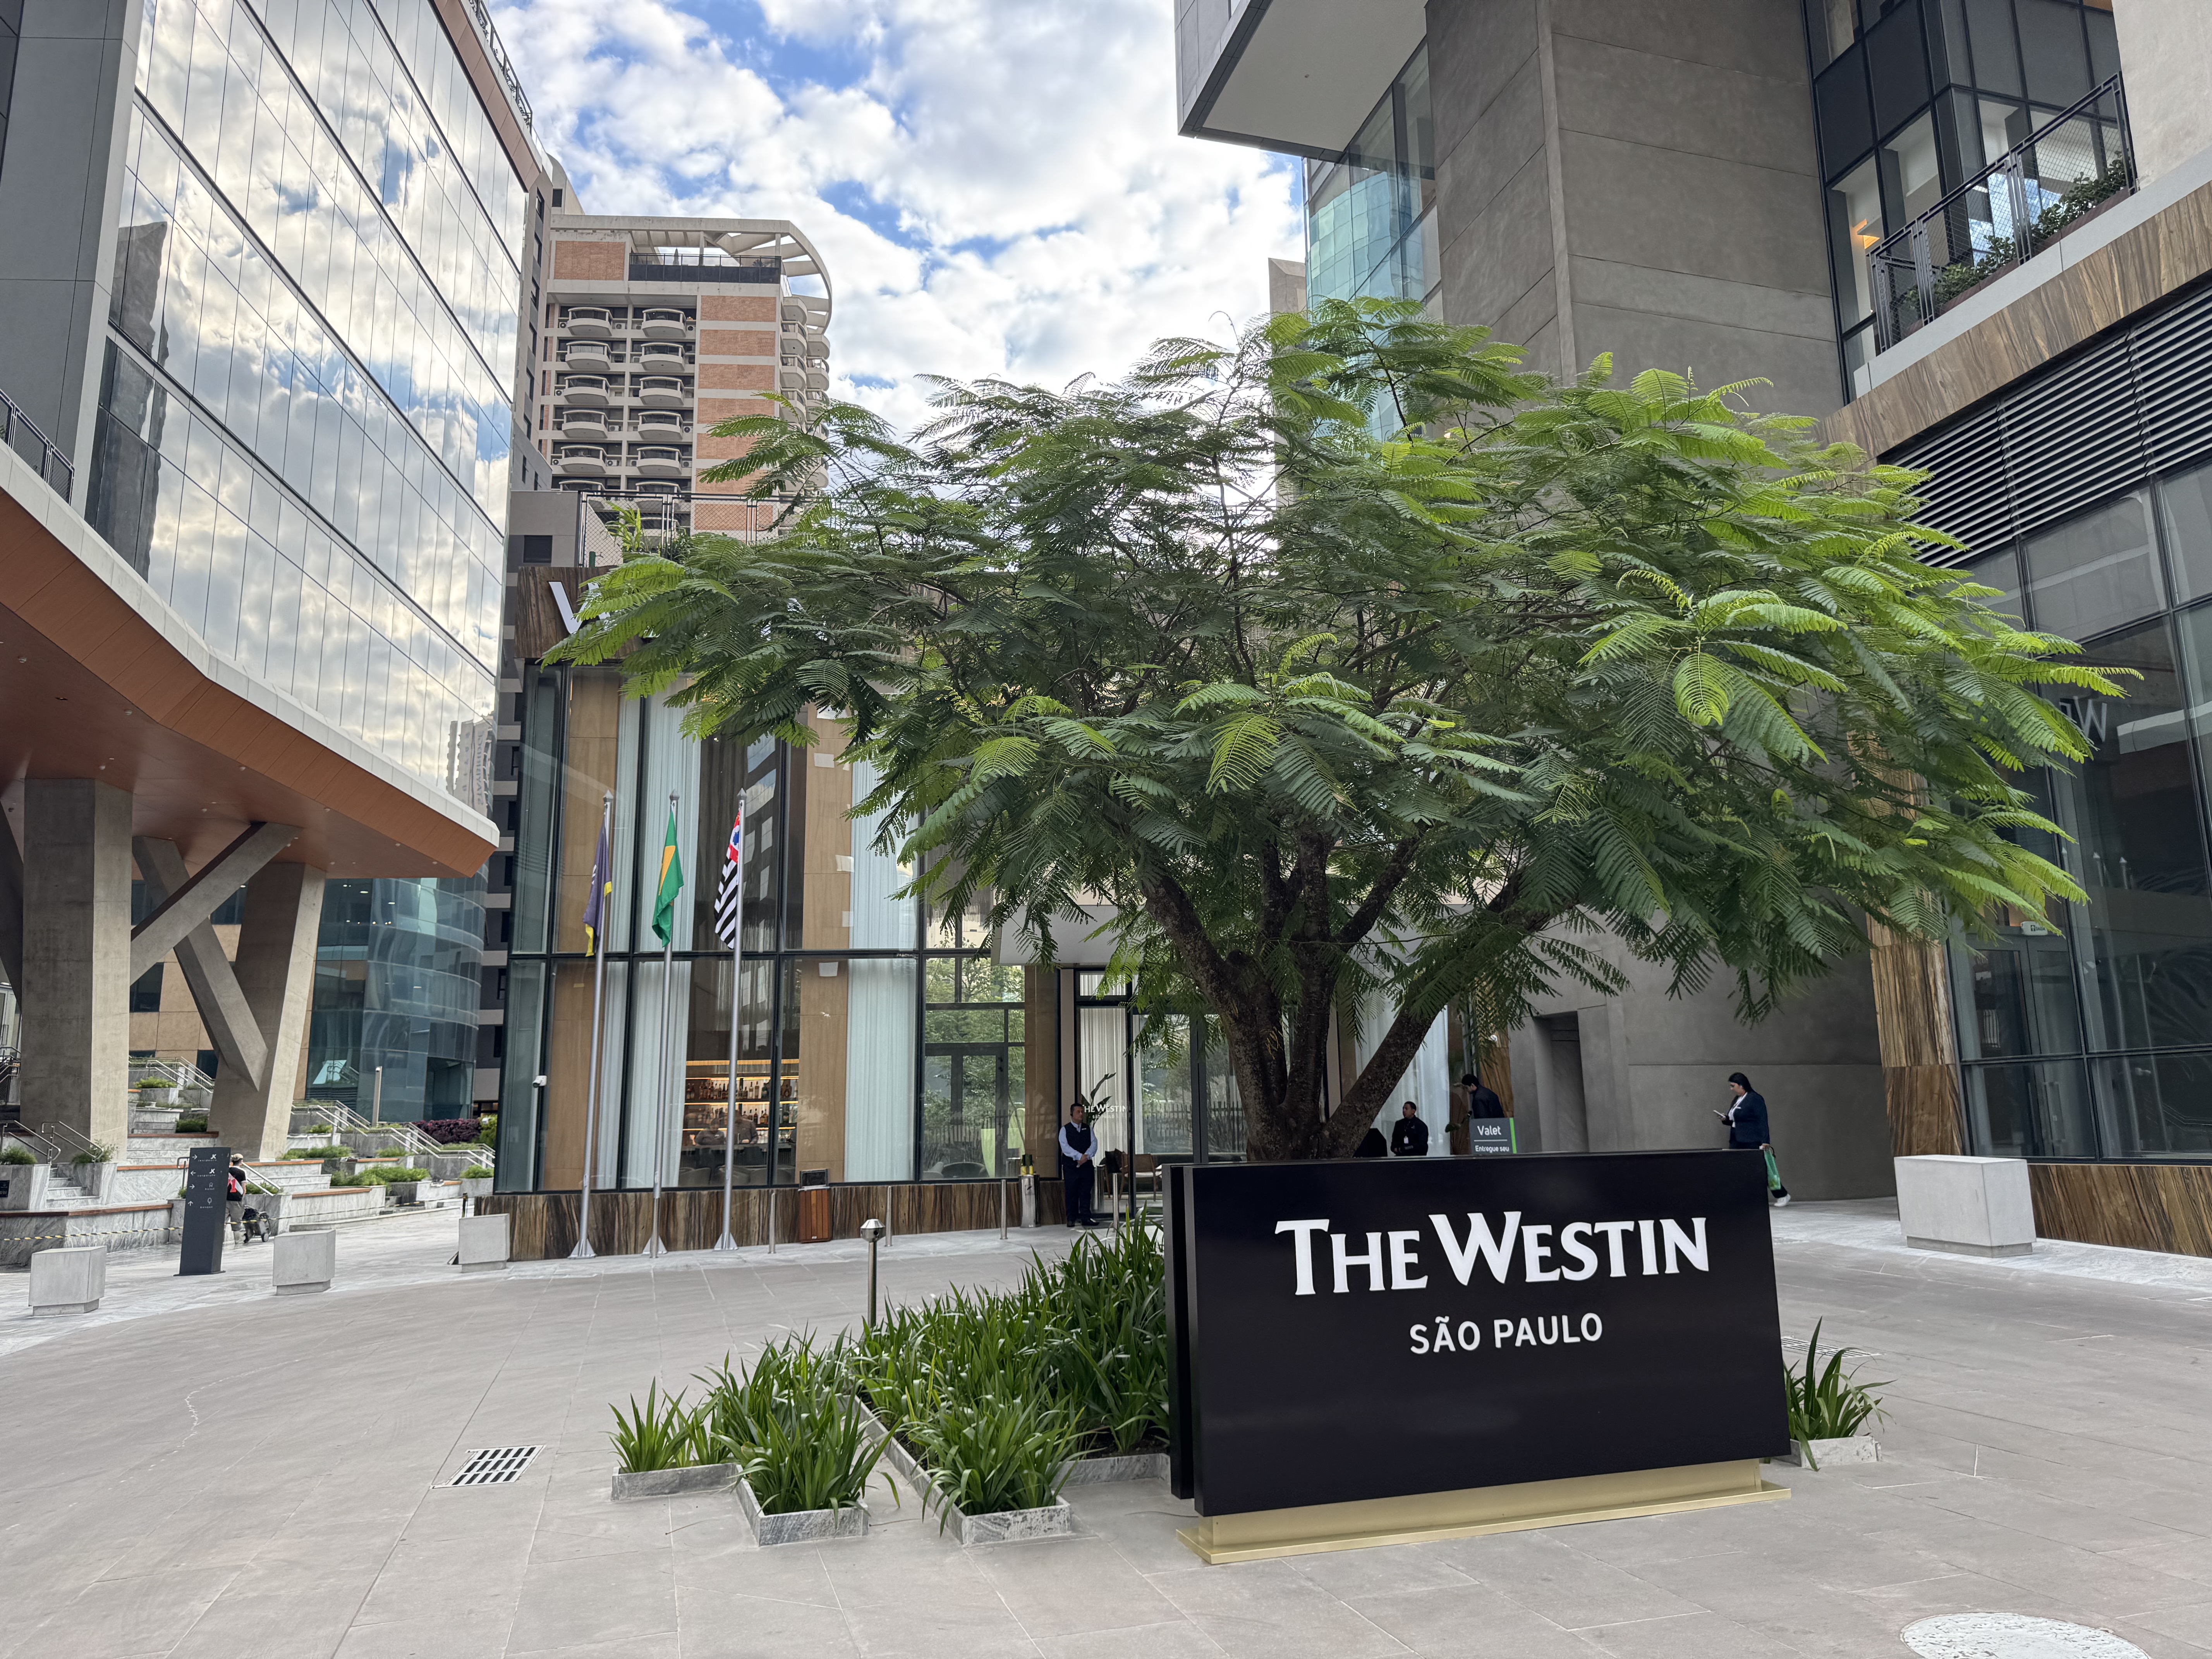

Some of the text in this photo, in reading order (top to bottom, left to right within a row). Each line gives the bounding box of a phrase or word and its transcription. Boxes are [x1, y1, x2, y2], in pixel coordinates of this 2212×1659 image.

[1082, 1104, 1127, 1113] HE WESTIN
[1477, 1125, 1501, 1135] Valet
[1274, 1211, 1709, 1295] THE WESTIN
[1410, 1313, 1602, 1354] SÃO PAULO
